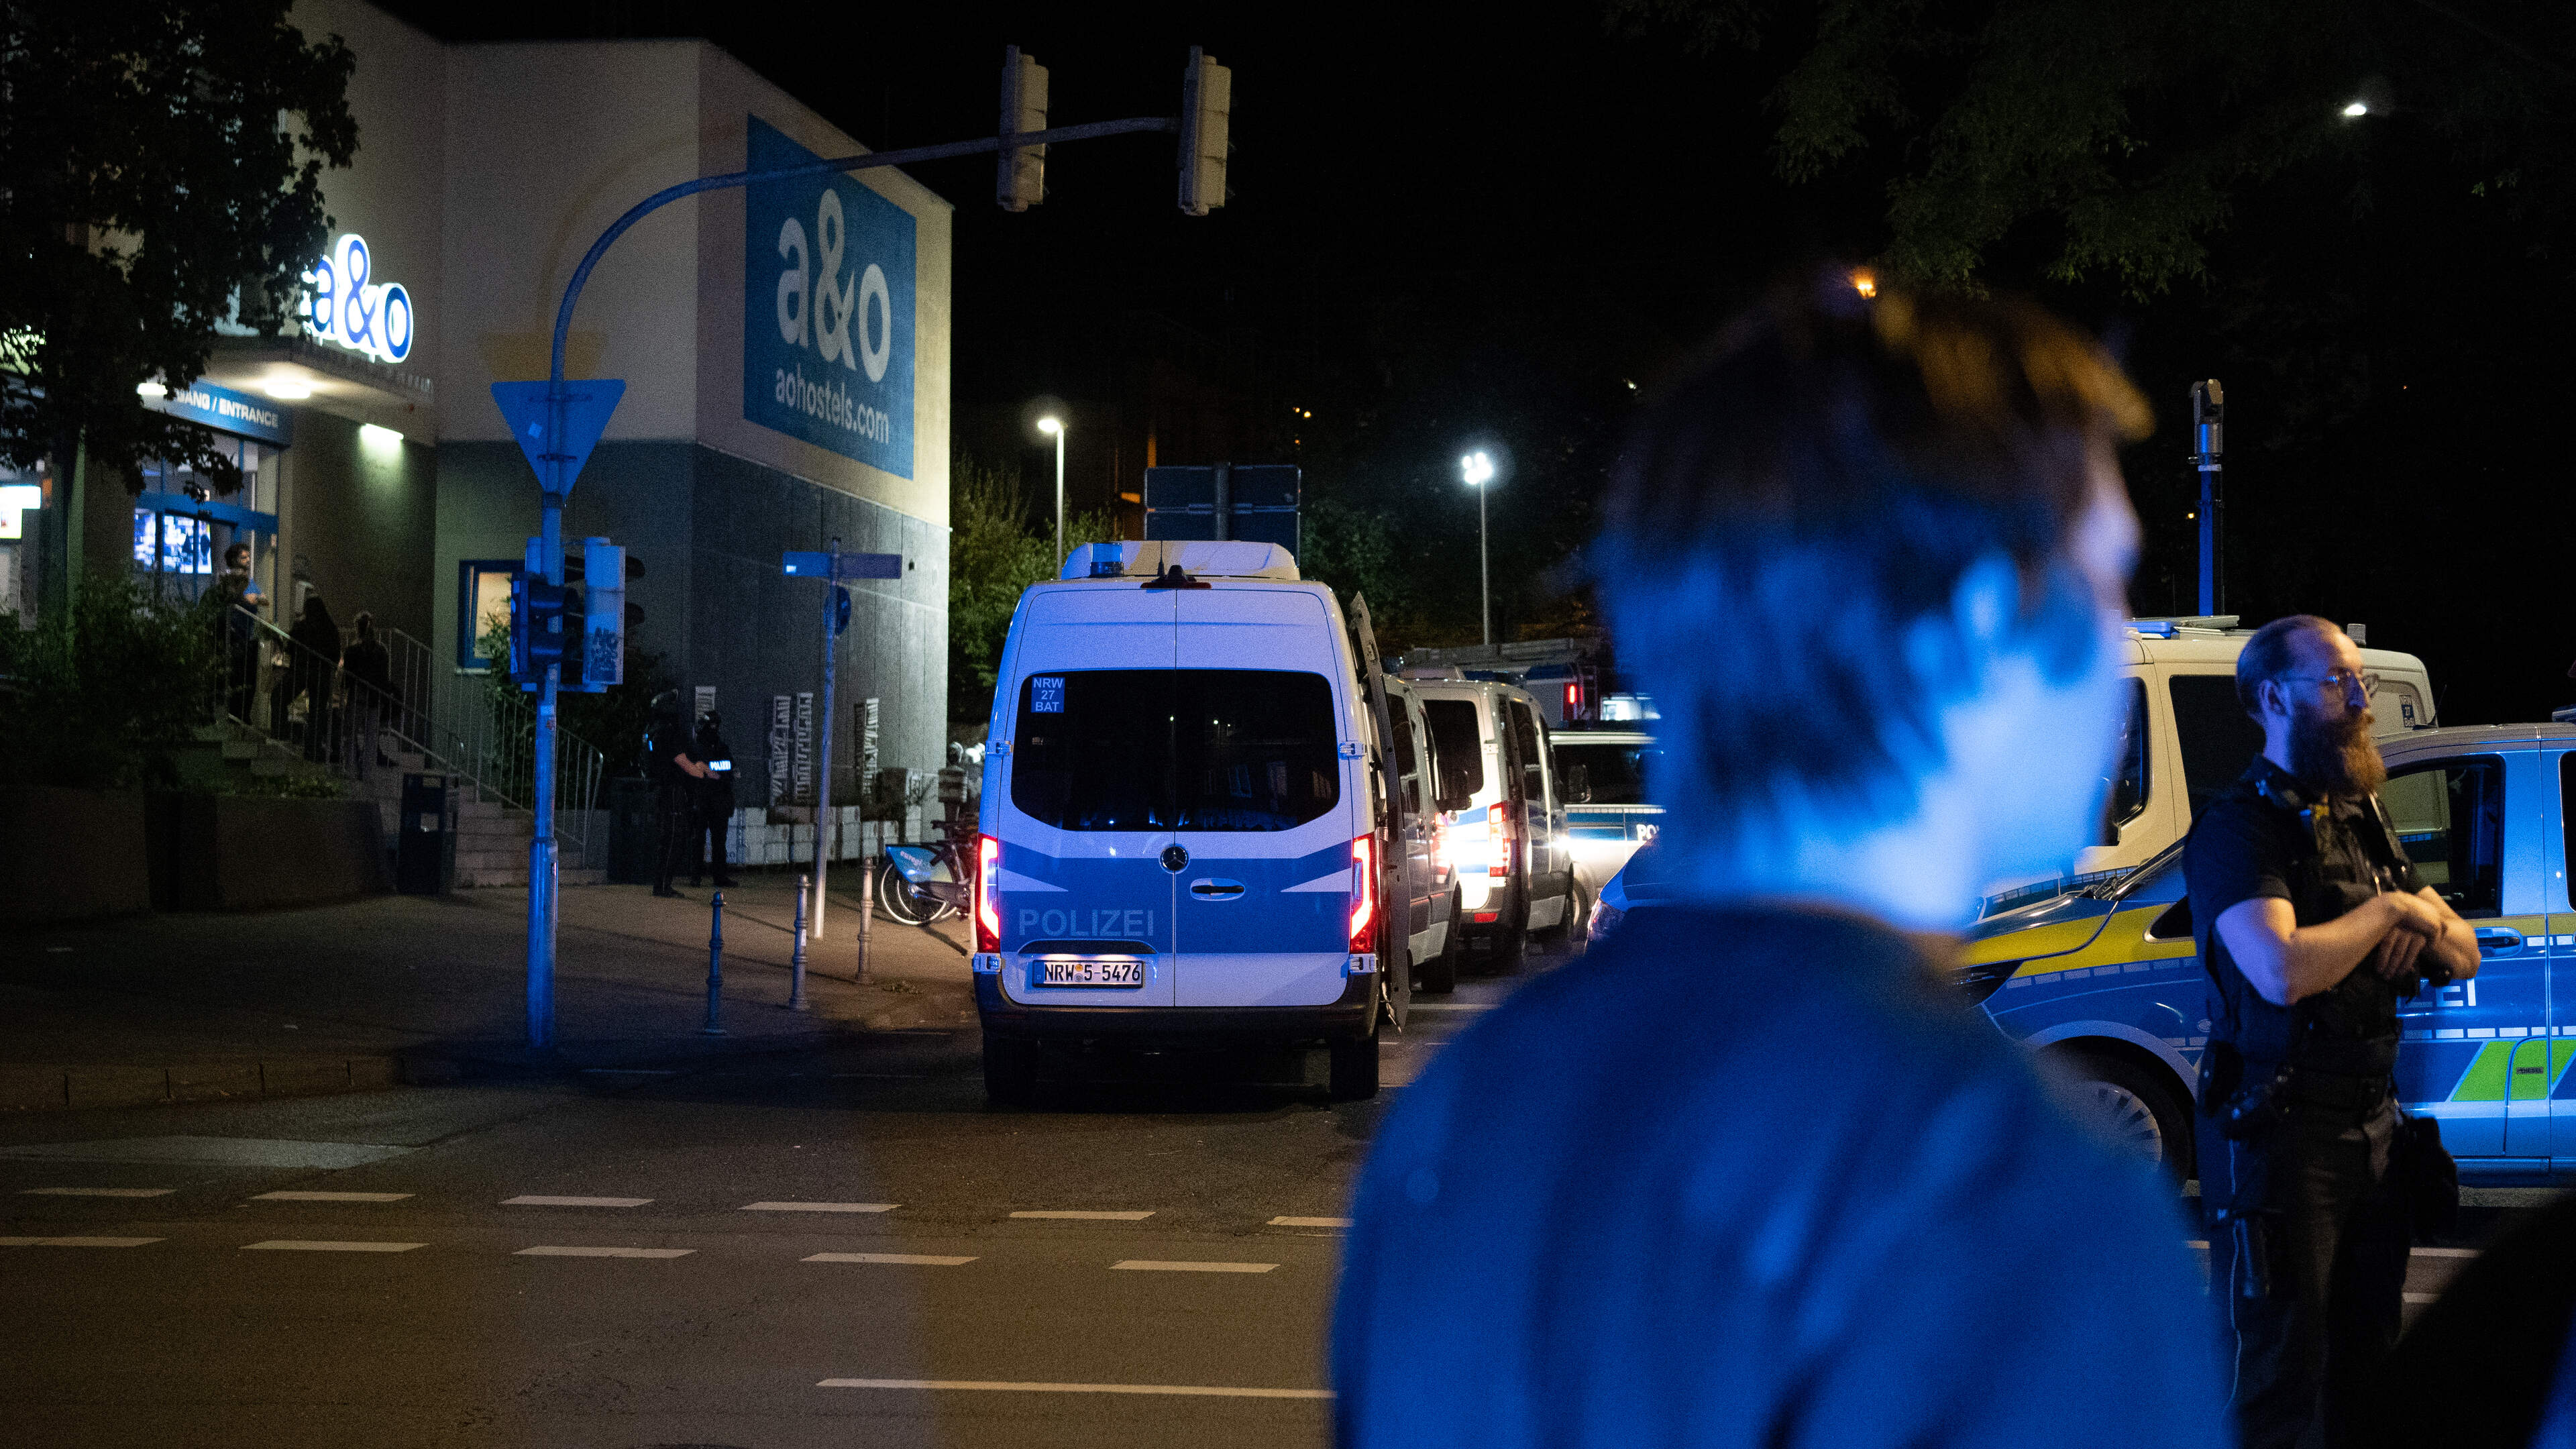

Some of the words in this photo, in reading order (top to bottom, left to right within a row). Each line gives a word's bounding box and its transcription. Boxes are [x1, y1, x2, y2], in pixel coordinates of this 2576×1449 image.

[777, 189, 891, 382] a&o
[305, 234, 413, 363] a&o
[219, 398, 279, 429] ENTRANCE
[775, 367, 890, 444] aohostels.com
[1034, 678, 1063, 688] NRW
[1041, 689, 1054, 700] 27
[1035, 702, 1060, 712] BAT
[710, 761, 731, 770] POLIZEI
[1636, 823, 1660, 841] PO
[1019, 909, 1154, 936] POLIZEI
[1044, 965, 1075, 981] NRW
[1084, 965, 1140, 981] 5-5476
